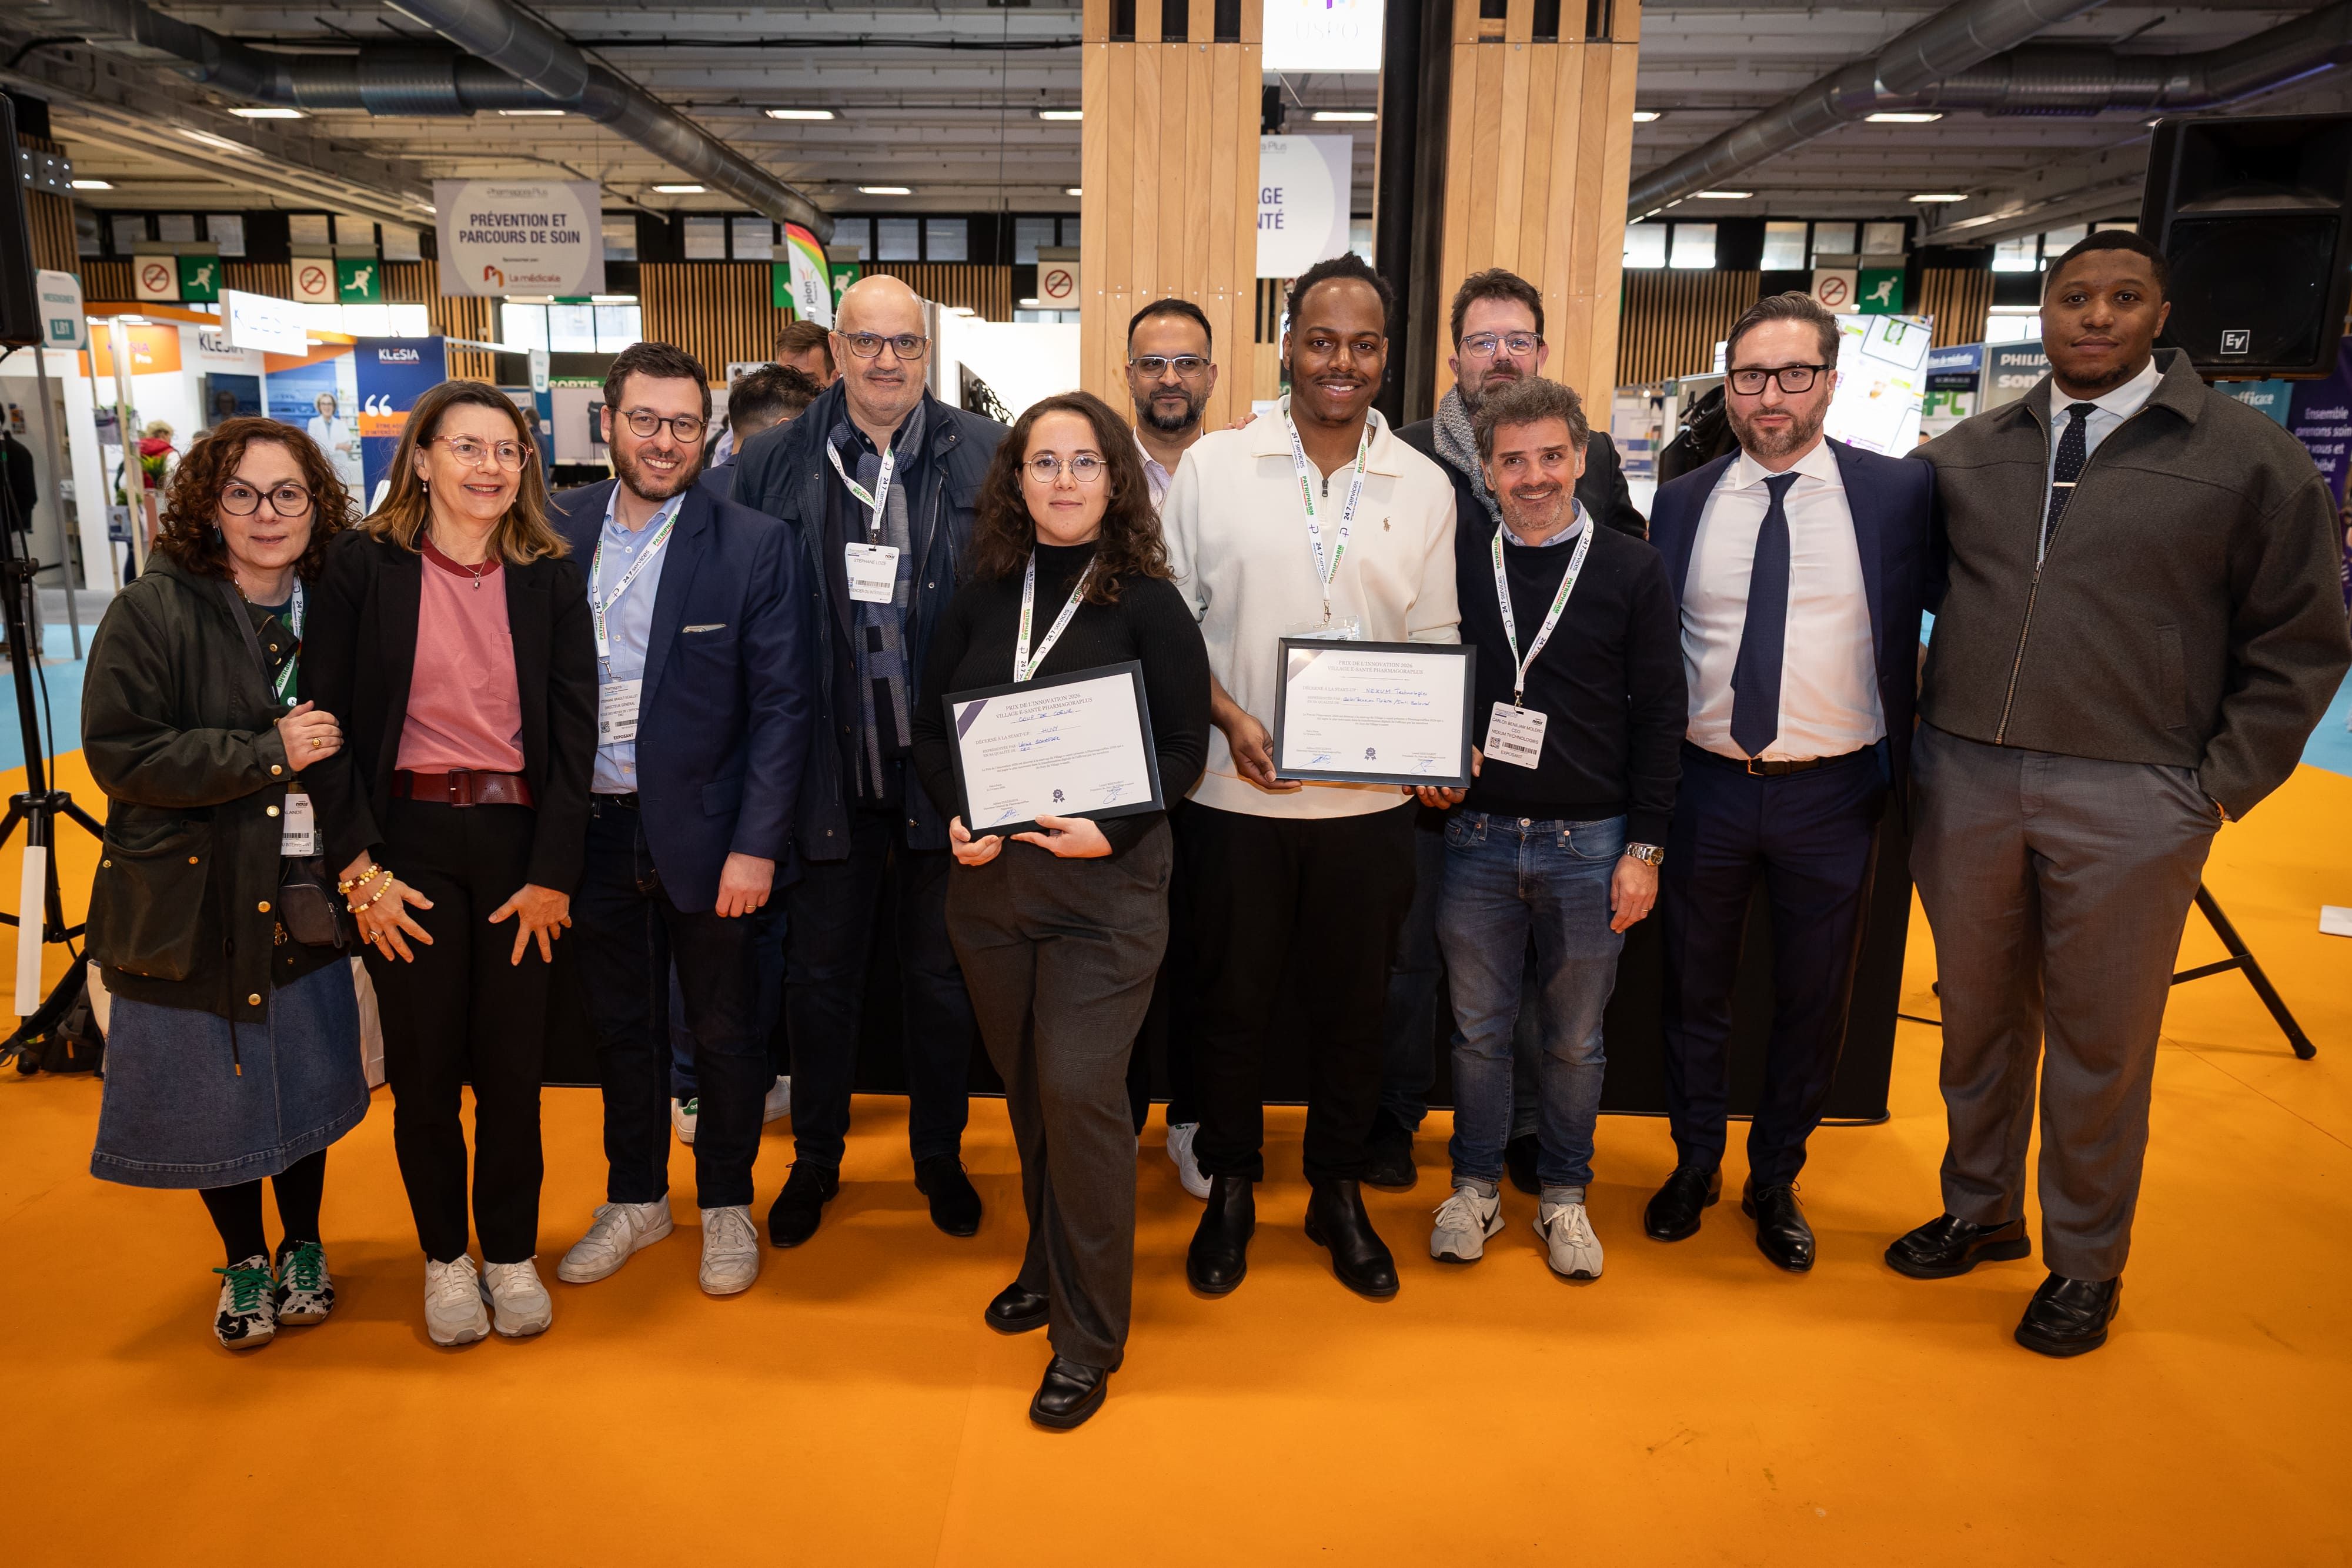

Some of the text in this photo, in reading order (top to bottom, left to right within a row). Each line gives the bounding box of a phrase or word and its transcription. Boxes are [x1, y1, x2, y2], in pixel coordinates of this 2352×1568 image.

[1258, 188, 1283, 204] GE
[470, 211, 567, 227] PRÉVENTION ET
[459, 230, 580, 244] PARCOURS DE SOIN
[520, 273, 561, 282] médicale
[2000, 353, 2052, 366] PHILIP
[2305, 406, 2349, 420] Ensemble
[2333, 442, 2346, 454] et
[1295, 444, 1305, 469] services
[1302, 476, 1314, 516] PATRIPHARM
[1344, 511, 1350, 521] 24
[1348, 480, 1359, 506] services
[653, 513, 677, 546] PATRIPHARM
[1315, 542, 1322, 550] 24
[622, 576, 629, 584] 24
[632, 550, 650, 572] services
[1328, 544, 1343, 584] PATRIPHARM
[1573, 549, 1586, 571] services
[1553, 577, 1573, 614] PATRIPHARM
[1054, 609, 1070, 631] services
[996, 697, 1093, 720] VILLAGE E-SANTÉ PHARMAGORAPLUS
[1028, 696, 1068, 707] L'INNOVATION
[1508, 721, 1526, 729] BENEJAM
[1507, 733, 1539, 744] TECHNOLOGIES
[1501, 750, 1522, 759] EXPOSANT
